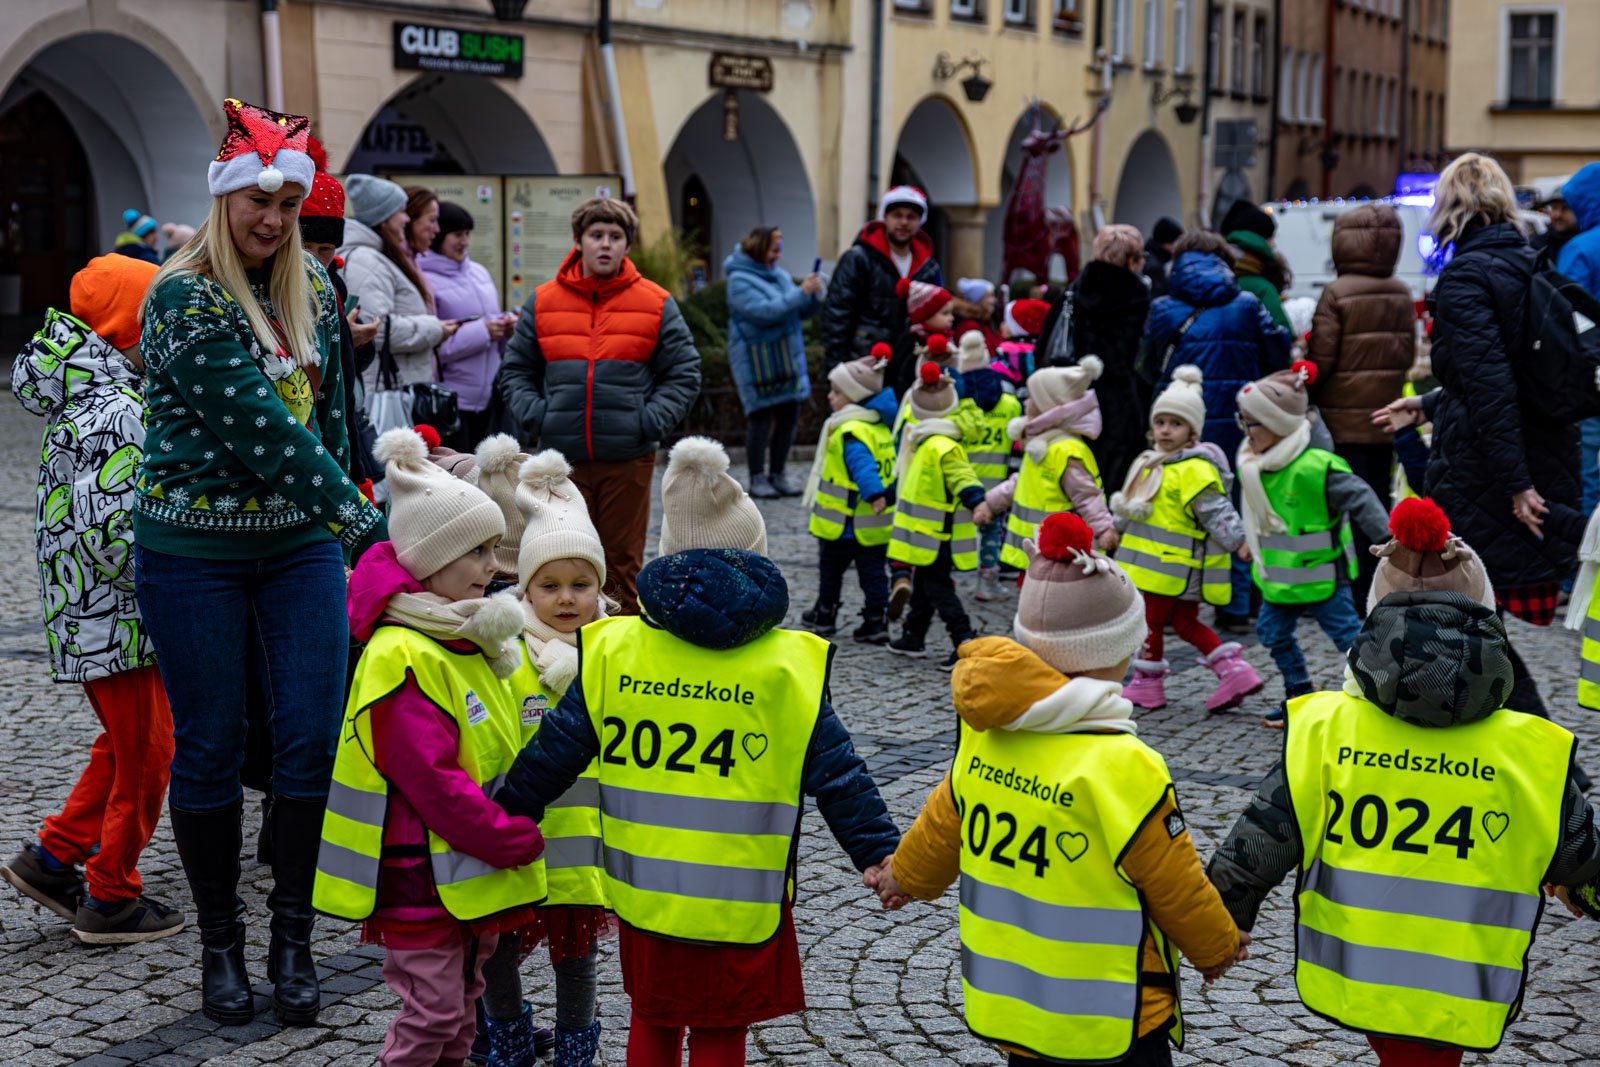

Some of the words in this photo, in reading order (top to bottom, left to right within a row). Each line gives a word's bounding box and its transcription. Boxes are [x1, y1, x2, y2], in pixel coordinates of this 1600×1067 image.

[400, 25, 459, 57] CLUB
[461, 33, 521, 62] SUSHI
[619, 675, 754, 705] Przedszkole
[602, 716, 736, 778] 2024
[1337, 747, 1496, 781] Przedszkole
[968, 756, 1074, 807] Przedszkole
[959, 795, 1050, 878] 024
[1325, 789, 1475, 860] 2024
